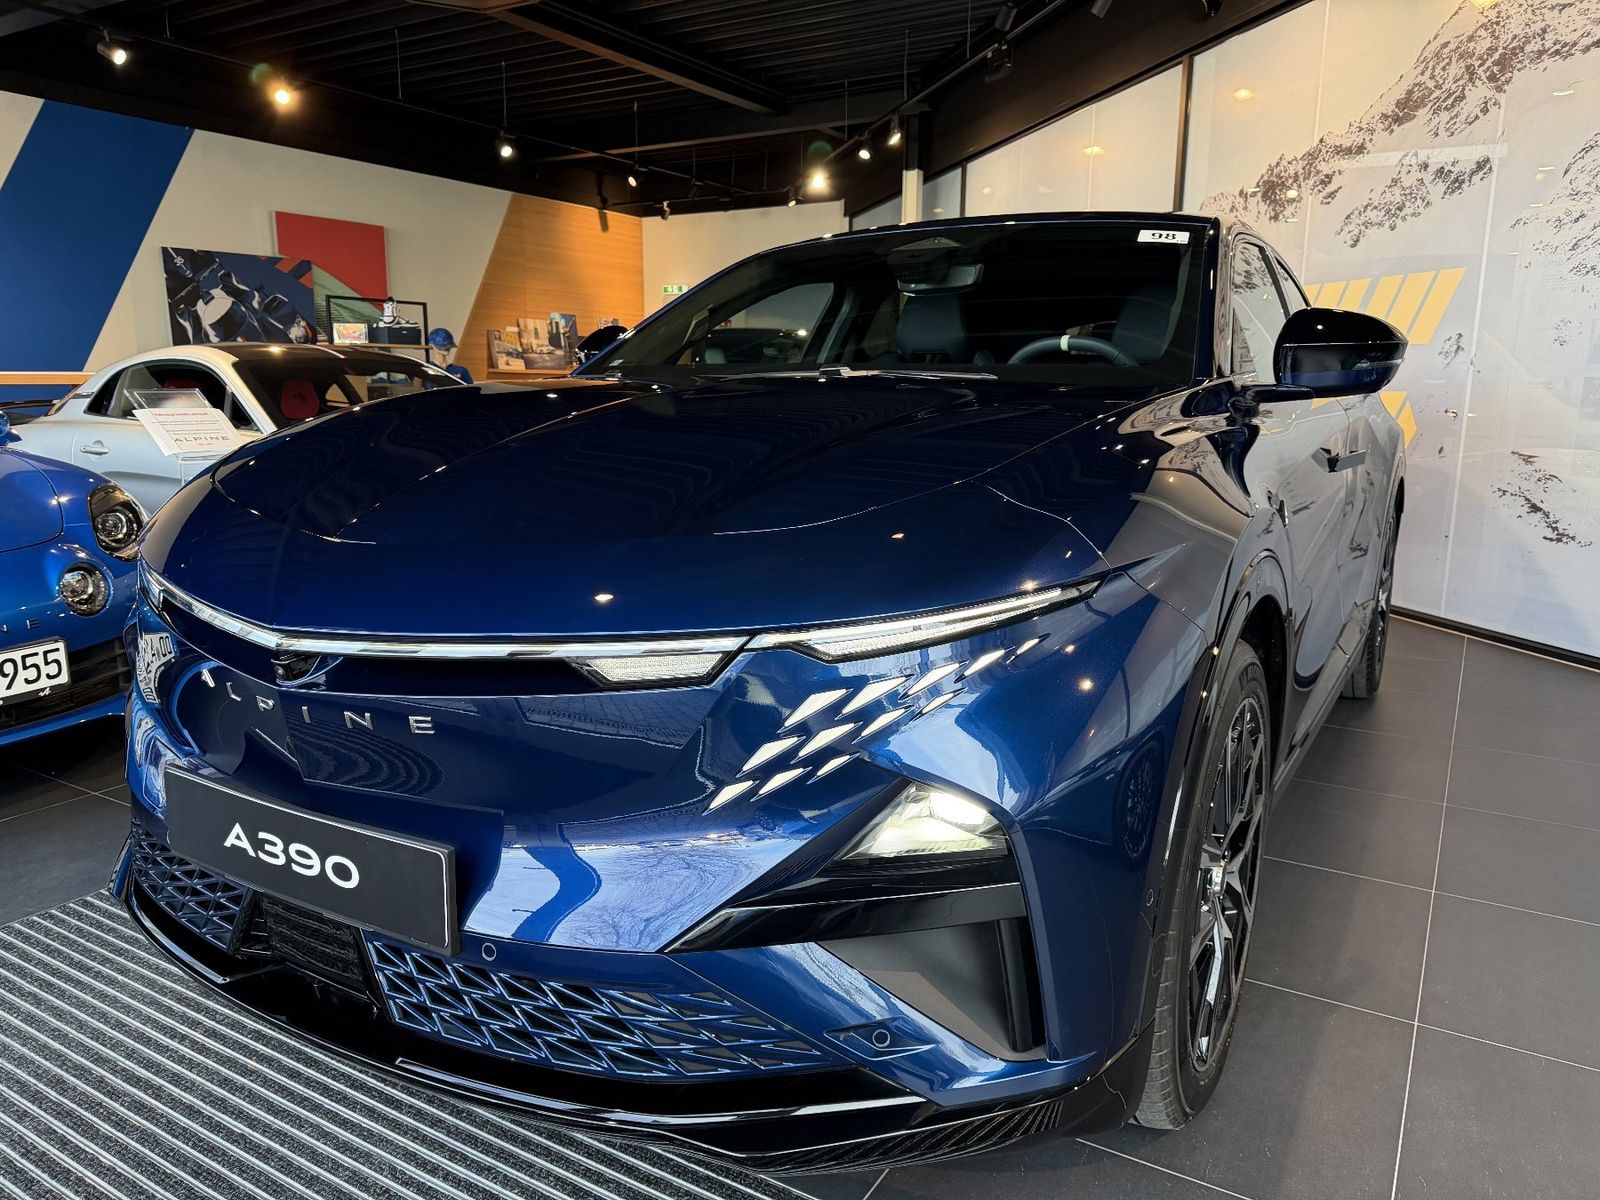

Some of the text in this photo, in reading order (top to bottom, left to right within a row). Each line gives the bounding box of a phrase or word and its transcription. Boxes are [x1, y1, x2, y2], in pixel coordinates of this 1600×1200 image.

[174, 435, 231, 443] ALPINE
[0, 647, 63, 691] 955
[201, 668, 436, 735] ALPINE
[223, 822, 360, 889] A390
